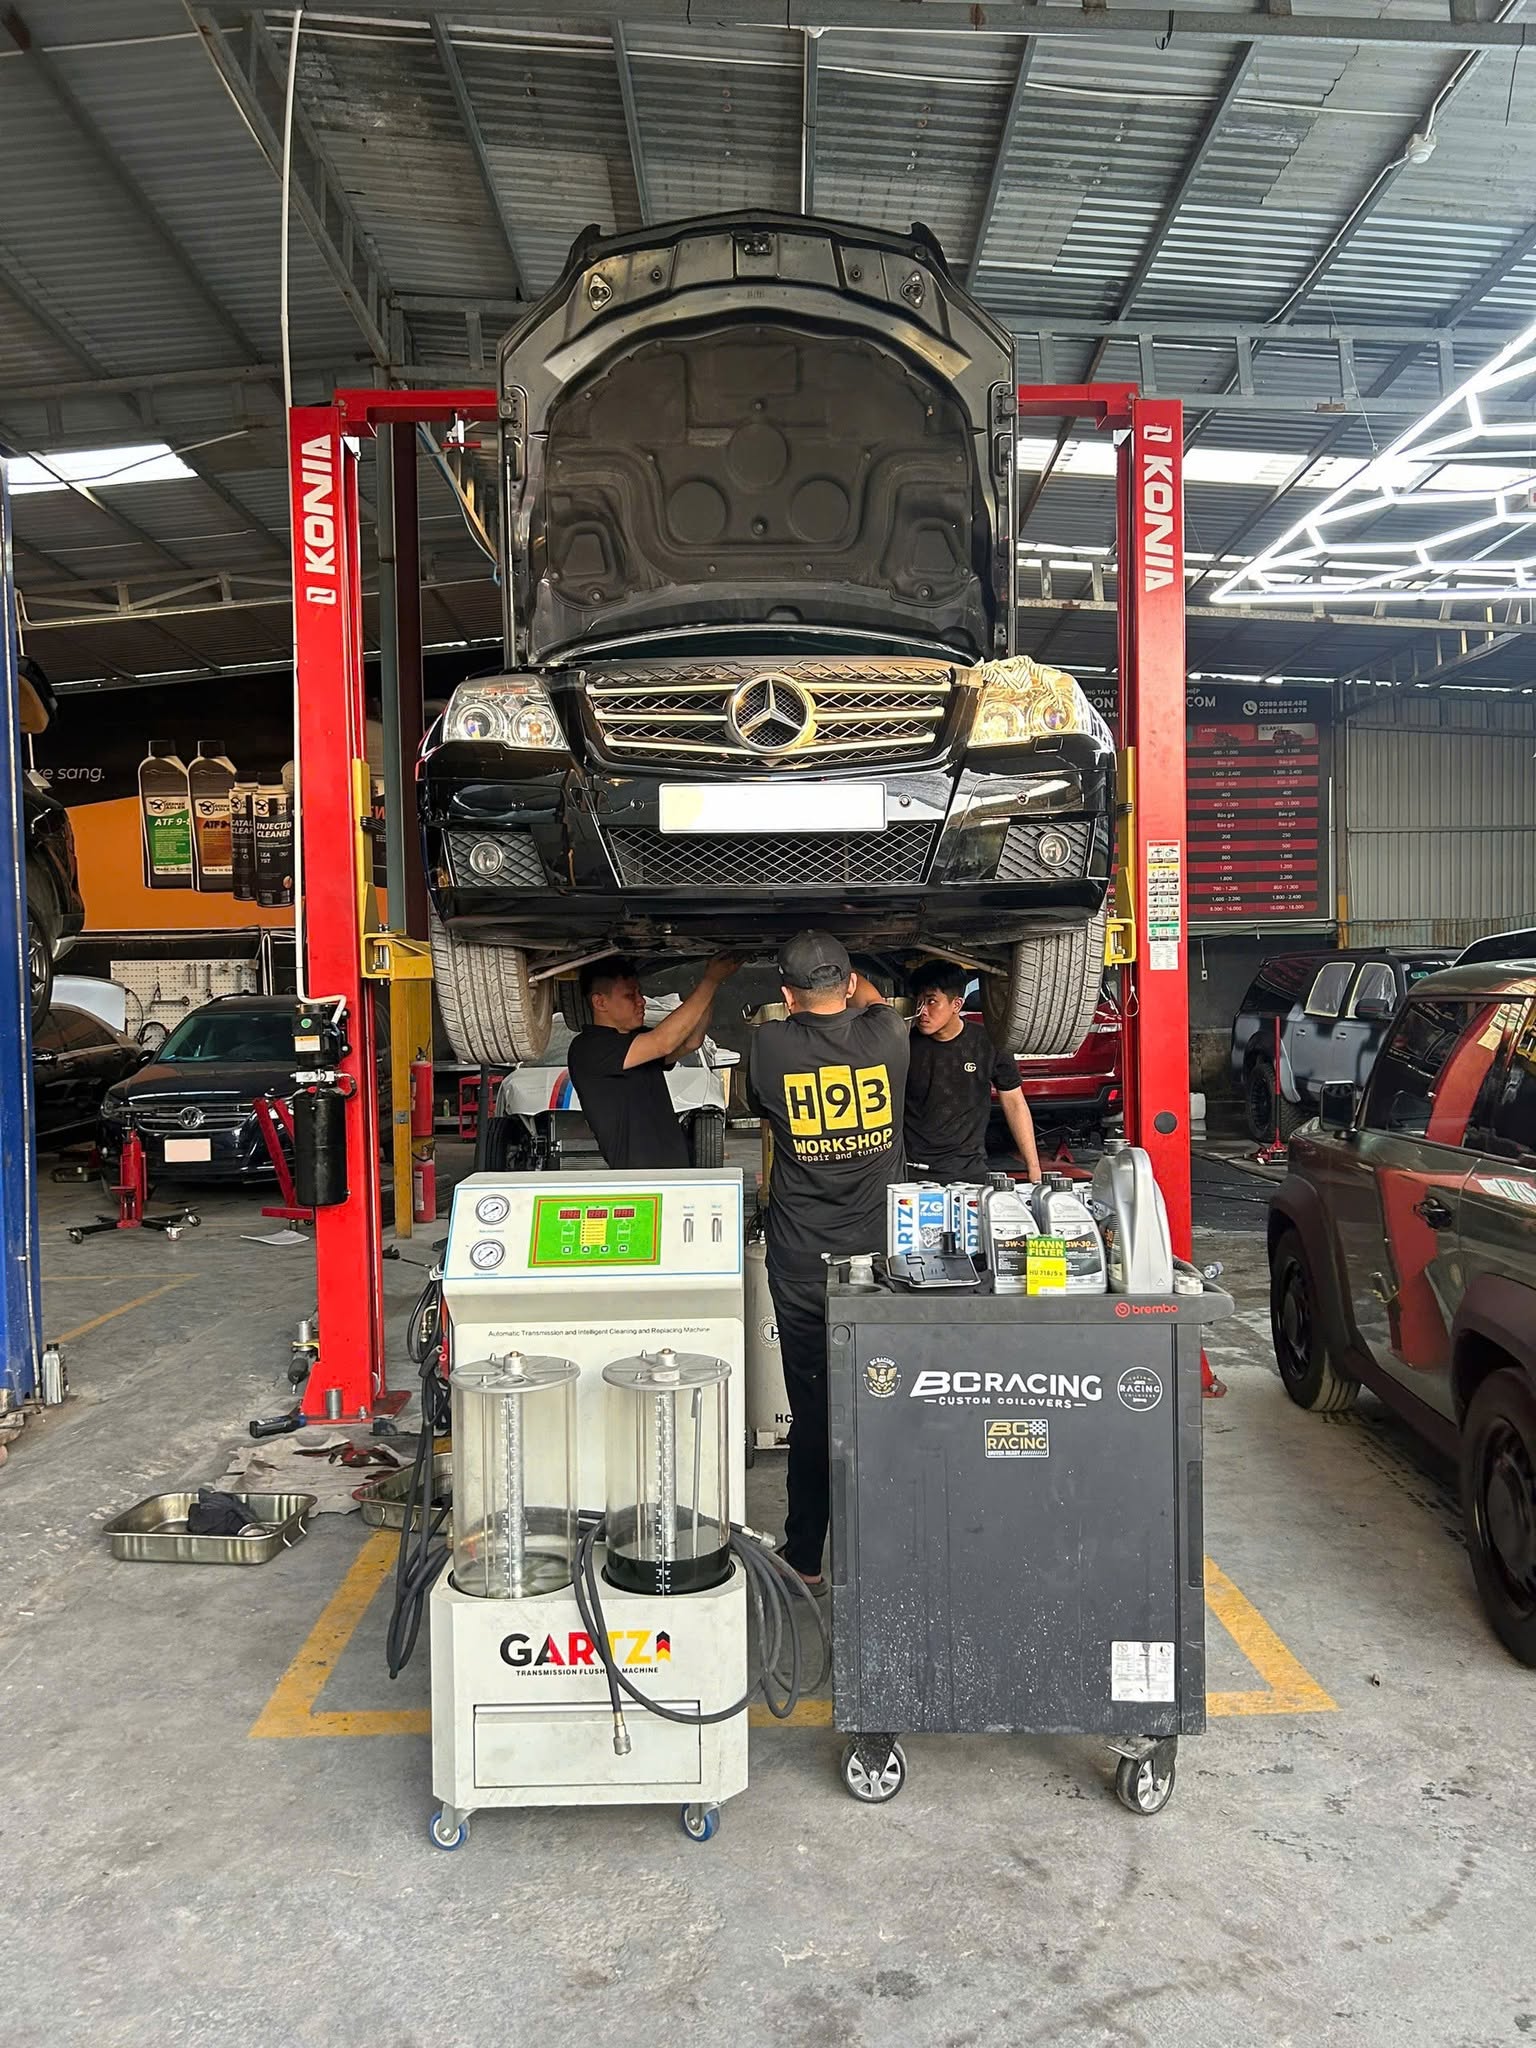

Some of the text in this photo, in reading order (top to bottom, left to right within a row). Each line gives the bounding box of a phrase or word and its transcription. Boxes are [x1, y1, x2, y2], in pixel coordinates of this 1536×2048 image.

[301, 434, 336, 575] KONIA
[1143, 454, 1175, 592] KONIA
[57, 768, 105, 783] sang.
[155, 818, 174, 826] ATF
[203, 820, 219, 829] ATF
[789, 1079, 887, 1120] H93
[793, 1128, 892, 1154] WORKSHOP
[797, 1141, 892, 1162] repair and turning
[919, 1200, 944, 1212] 7G
[1030, 1240, 1064, 1249] MANN
[1029, 1248, 1064, 1257] FILTER
[1132, 1304, 1178, 1314] brembo
[521, 1329, 564, 1337] Transmission
[578, 1328, 608, 1337] Intelligent
[609, 1328, 637, 1336] Cleaning
[651, 1327, 682, 1335] Replacing
[1120, 1384, 1160, 1393] RACING
[939, 1397, 1072, 1409] CUSTOM COILOVERS
[988, 1422, 1029, 1436] BC
[988, 1437, 1046, 1450] RACING
